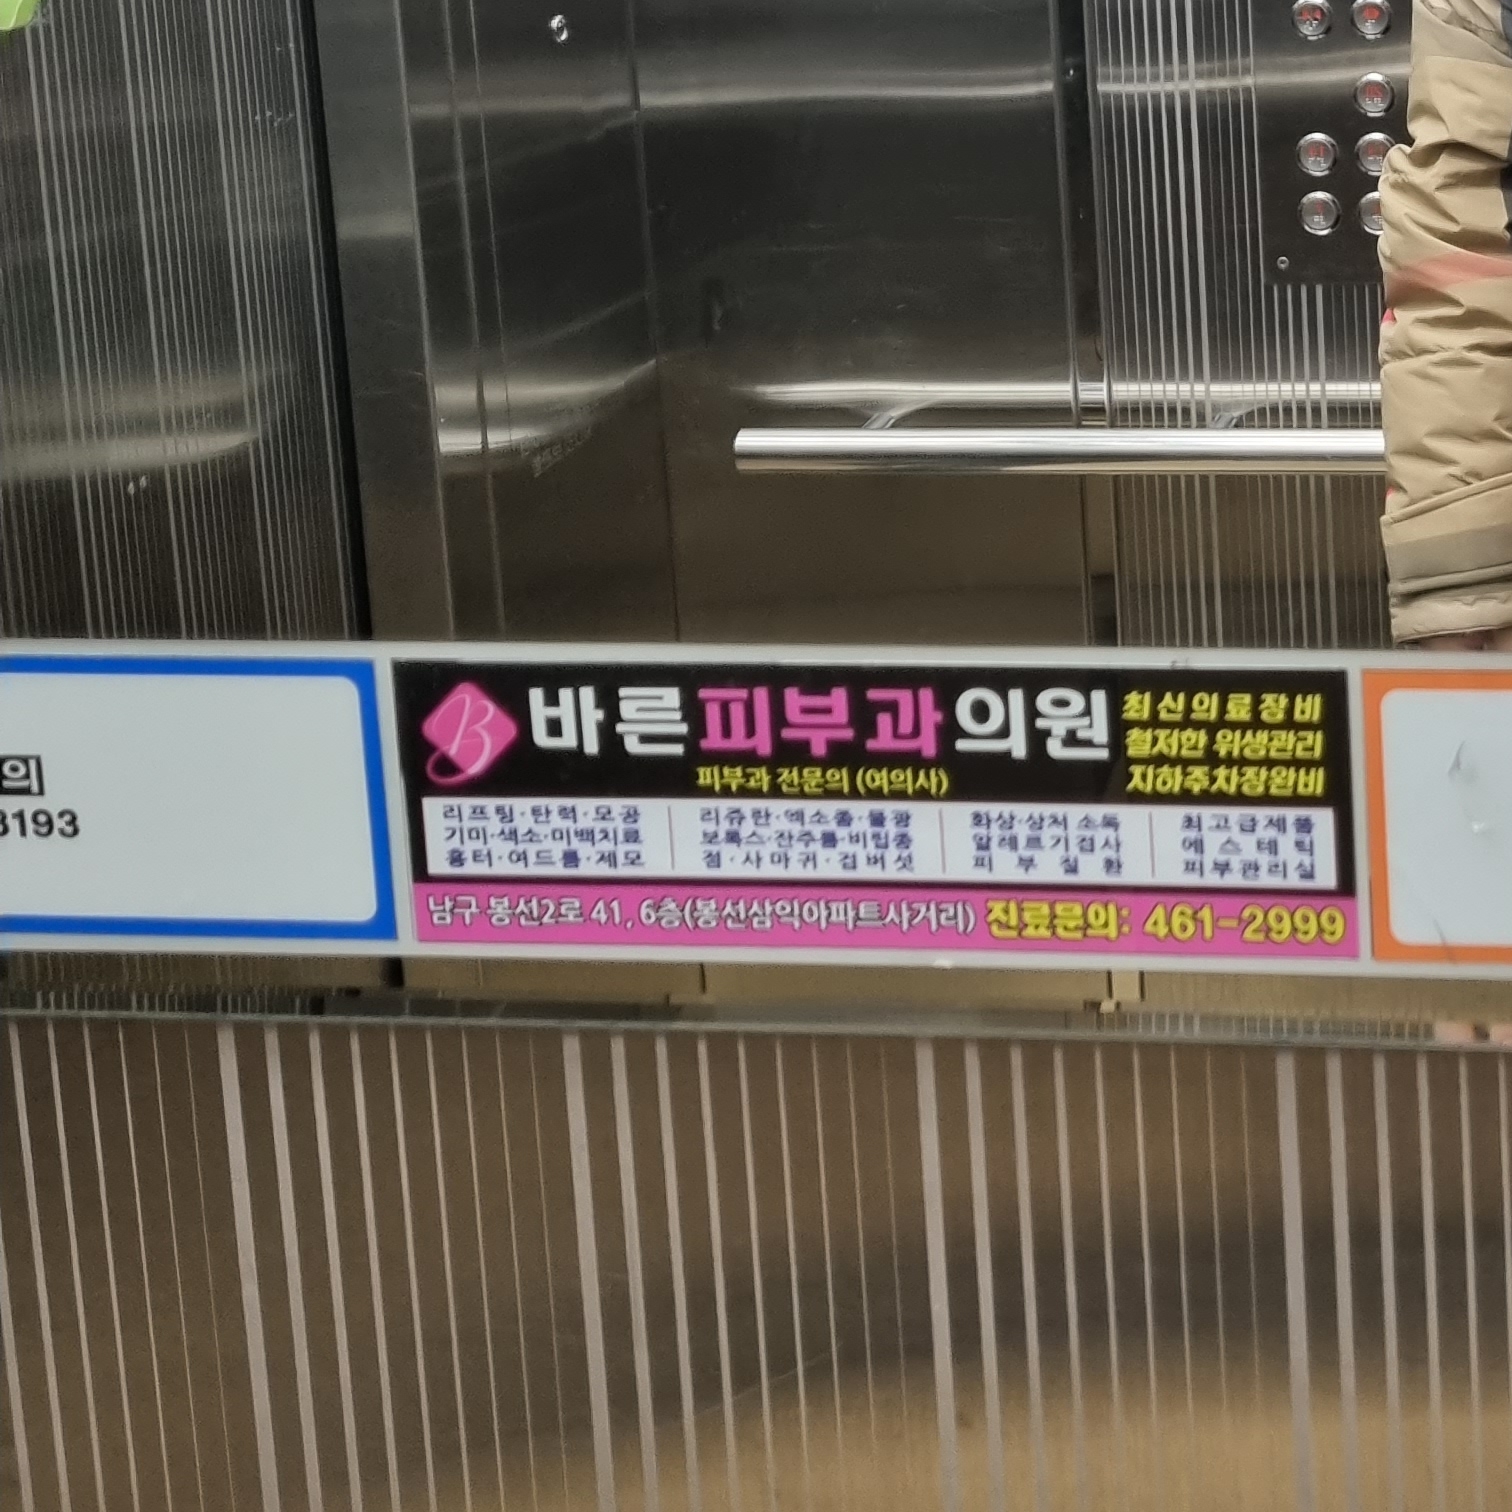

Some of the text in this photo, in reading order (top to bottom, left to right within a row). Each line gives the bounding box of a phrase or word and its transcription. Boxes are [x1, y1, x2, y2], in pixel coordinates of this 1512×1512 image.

[528, 685, 1110, 760] 바른피부과의원
[1125, 727, 1323, 759] 철저한 위생관리
[696, 765, 948, 796] 피부과 전문의 (여의사)
[1126, 764, 1325, 796] 지하주차장완비
[428, 895, 476, 924] 남구
[489, 896, 580, 925] 봉선2로
[985, 900, 1346, 943] 진료문의: 461-2999
